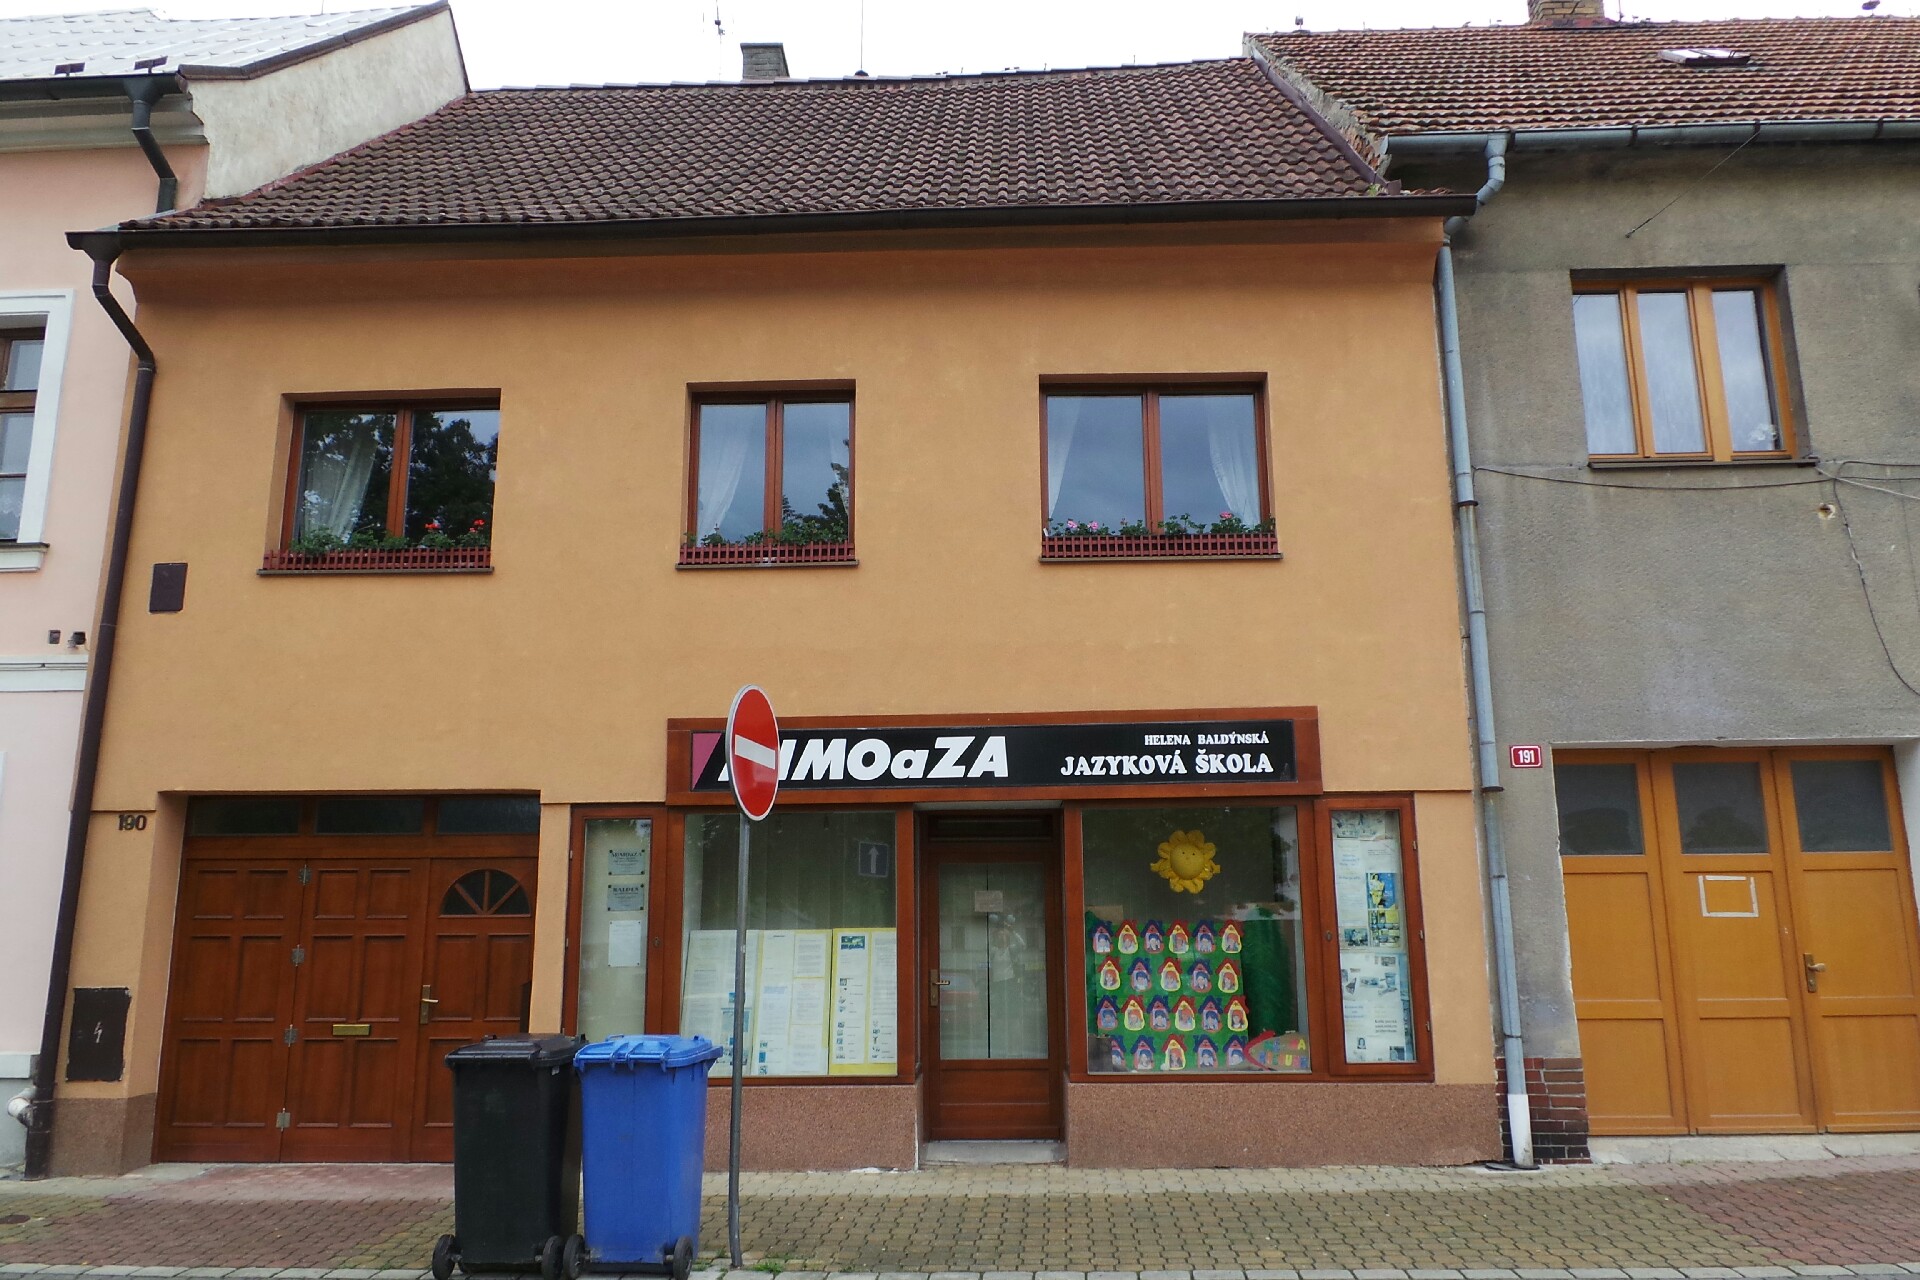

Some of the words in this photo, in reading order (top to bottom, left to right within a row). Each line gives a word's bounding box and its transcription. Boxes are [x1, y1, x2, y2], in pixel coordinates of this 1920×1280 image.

[1144, 734, 1191, 746] HELENA
[1197, 731, 1269, 745] BALDÝNSKÁ
[717, 736, 1008, 781] IMOaZA
[1061, 750, 1187, 775] JAZYKOVÁ
[1195, 748, 1274, 774] ŠKOLA
[1518, 749, 1535, 763] 191
[118, 814, 147, 830] 190
